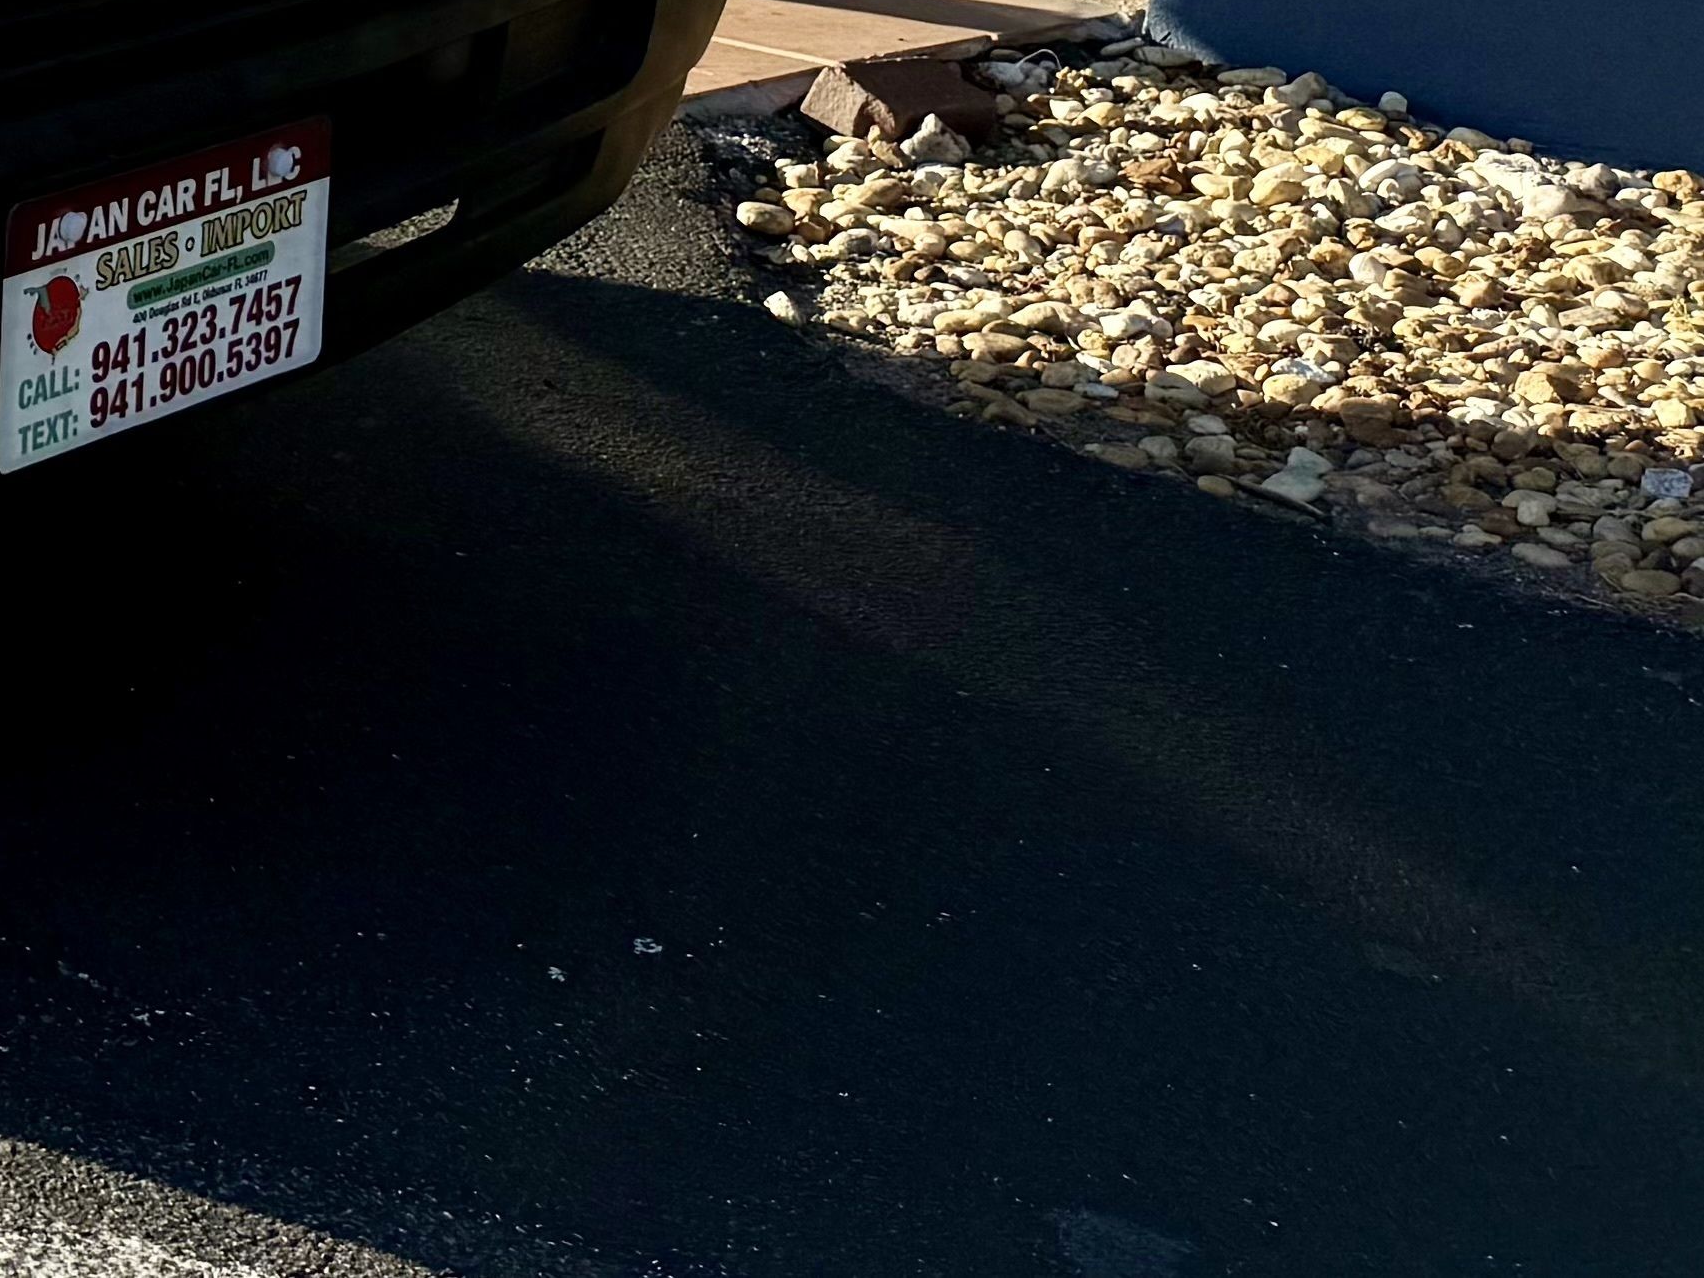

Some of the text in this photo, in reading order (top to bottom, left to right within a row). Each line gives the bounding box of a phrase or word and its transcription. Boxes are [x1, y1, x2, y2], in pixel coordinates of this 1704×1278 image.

[95, 189, 308, 292] SALES IMPORT
[137, 178, 196, 226] CAR
[204, 167, 243, 206] FL,
[251, 146, 302, 192] LC
[18, 368, 80, 411] CALL:
[91, 277, 303, 384] 941.323.7457
[18, 319, 301, 456] TEXT: 941.900.5397
